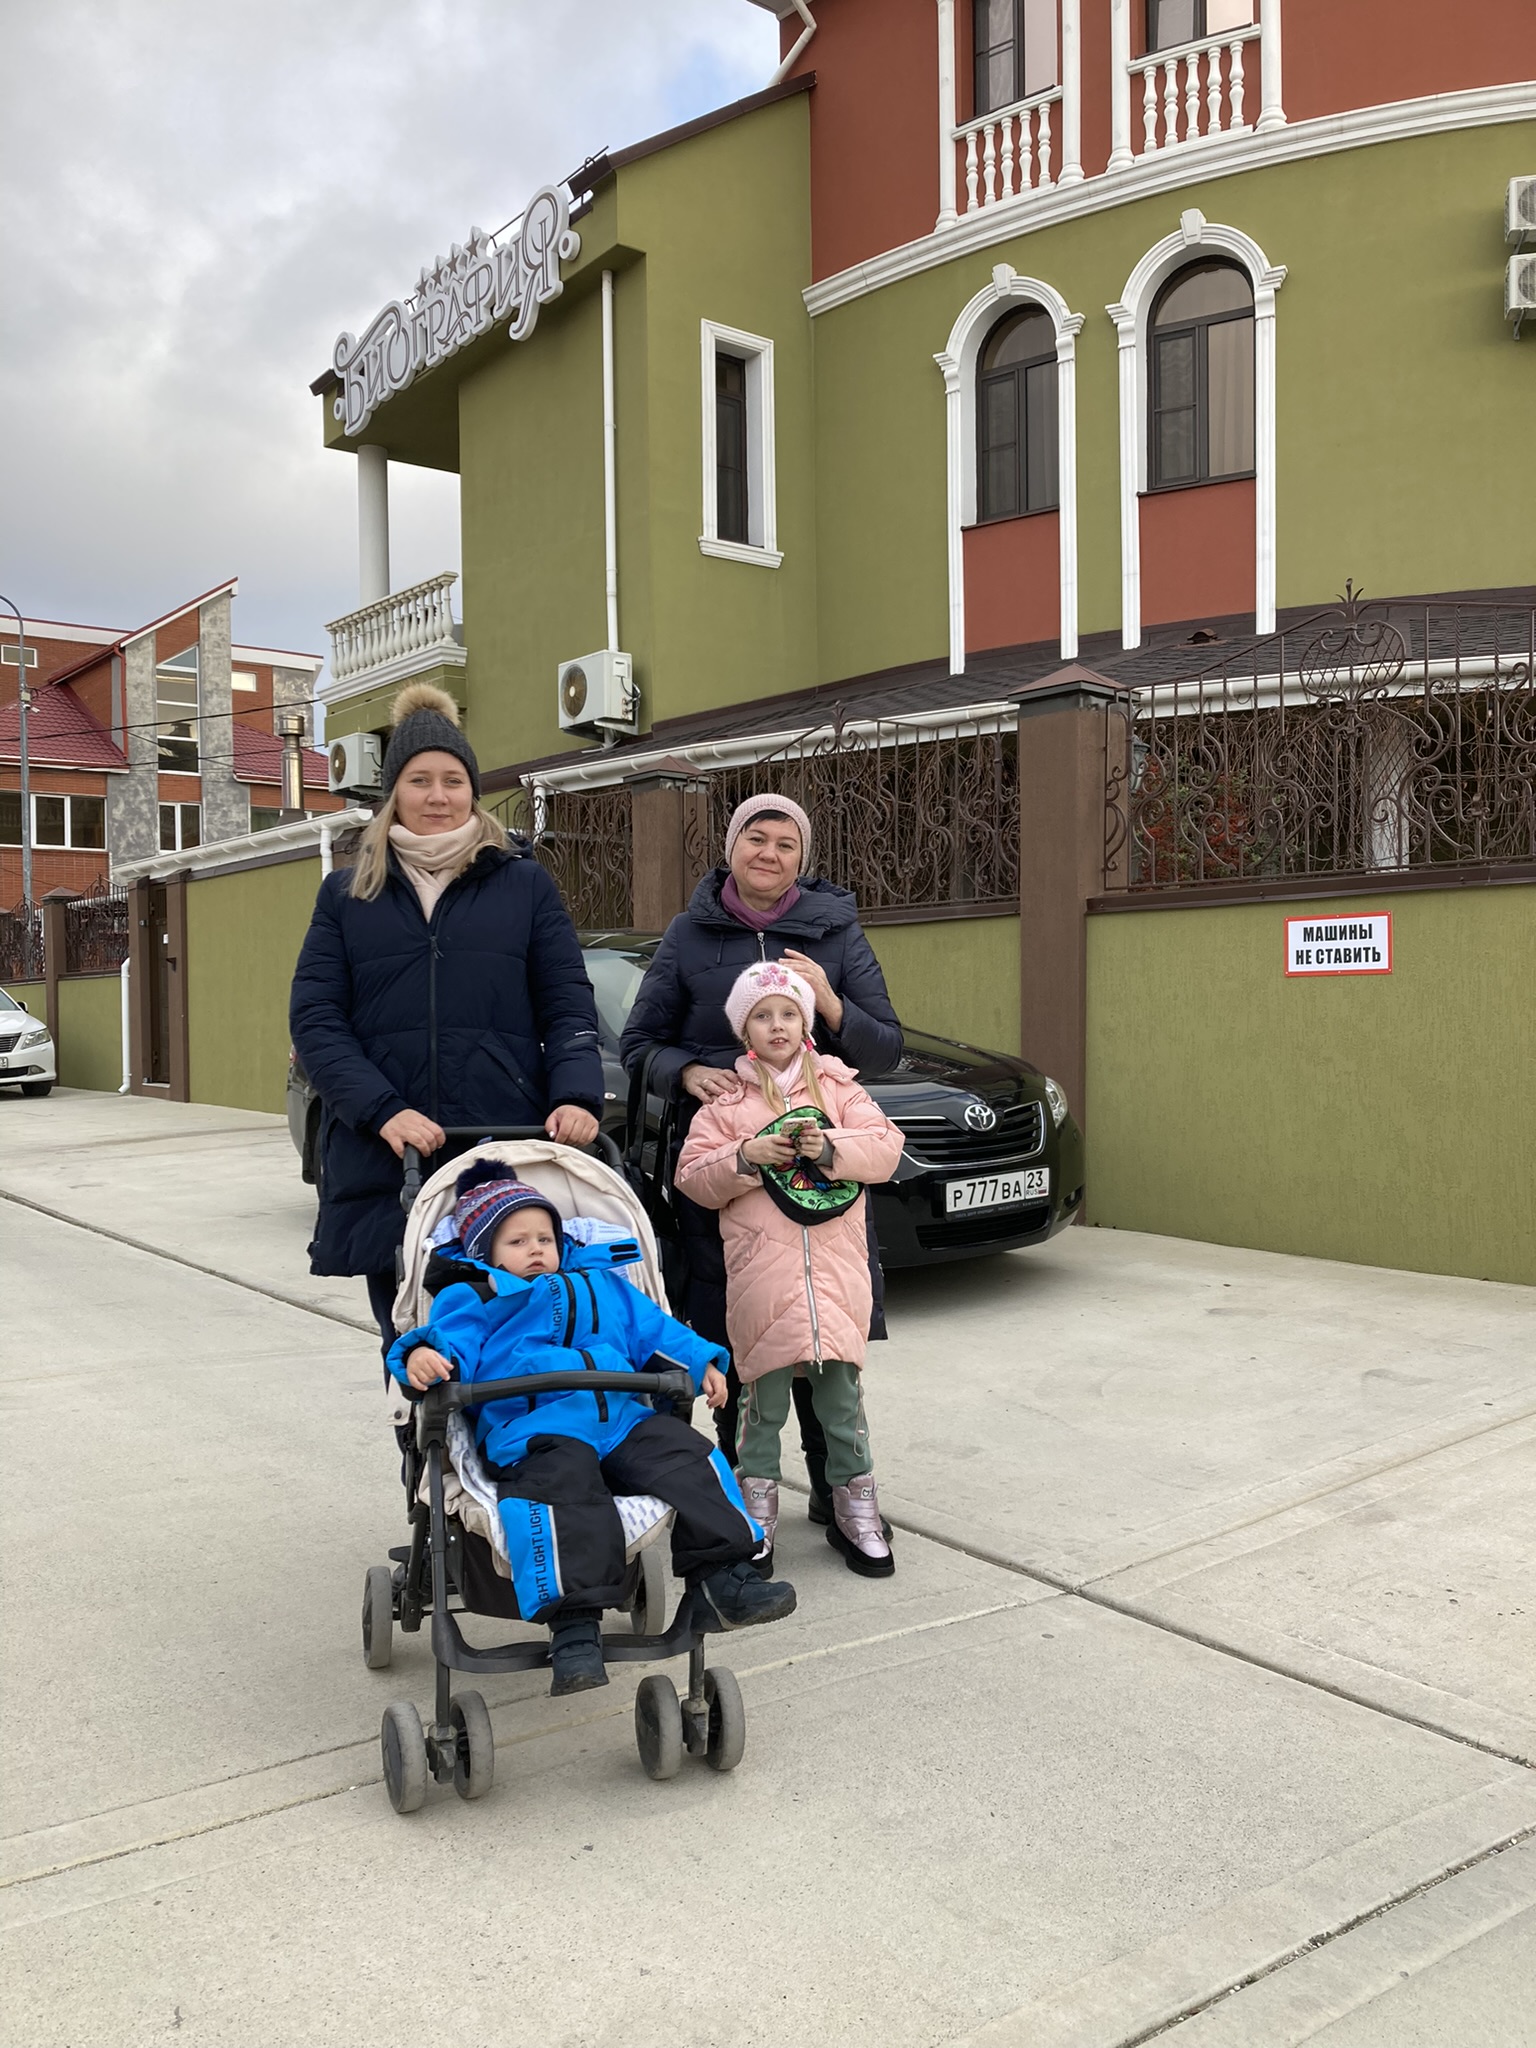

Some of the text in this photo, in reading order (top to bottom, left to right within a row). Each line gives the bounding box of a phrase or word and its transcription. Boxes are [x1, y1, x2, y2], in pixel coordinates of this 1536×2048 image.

[1303, 923, 1373, 942] МАШИНЫ
[1295, 946, 1381, 965] НЕ СТАВИТЬ
[1027, 1170, 1043, 1189] 23
[1026, 1188, 1038, 1196] RUS
[552, 1302, 562, 1332] LIGHT
[529, 1501, 542, 1536] LIGHT
[532, 1538, 546, 1575] LIGHT
